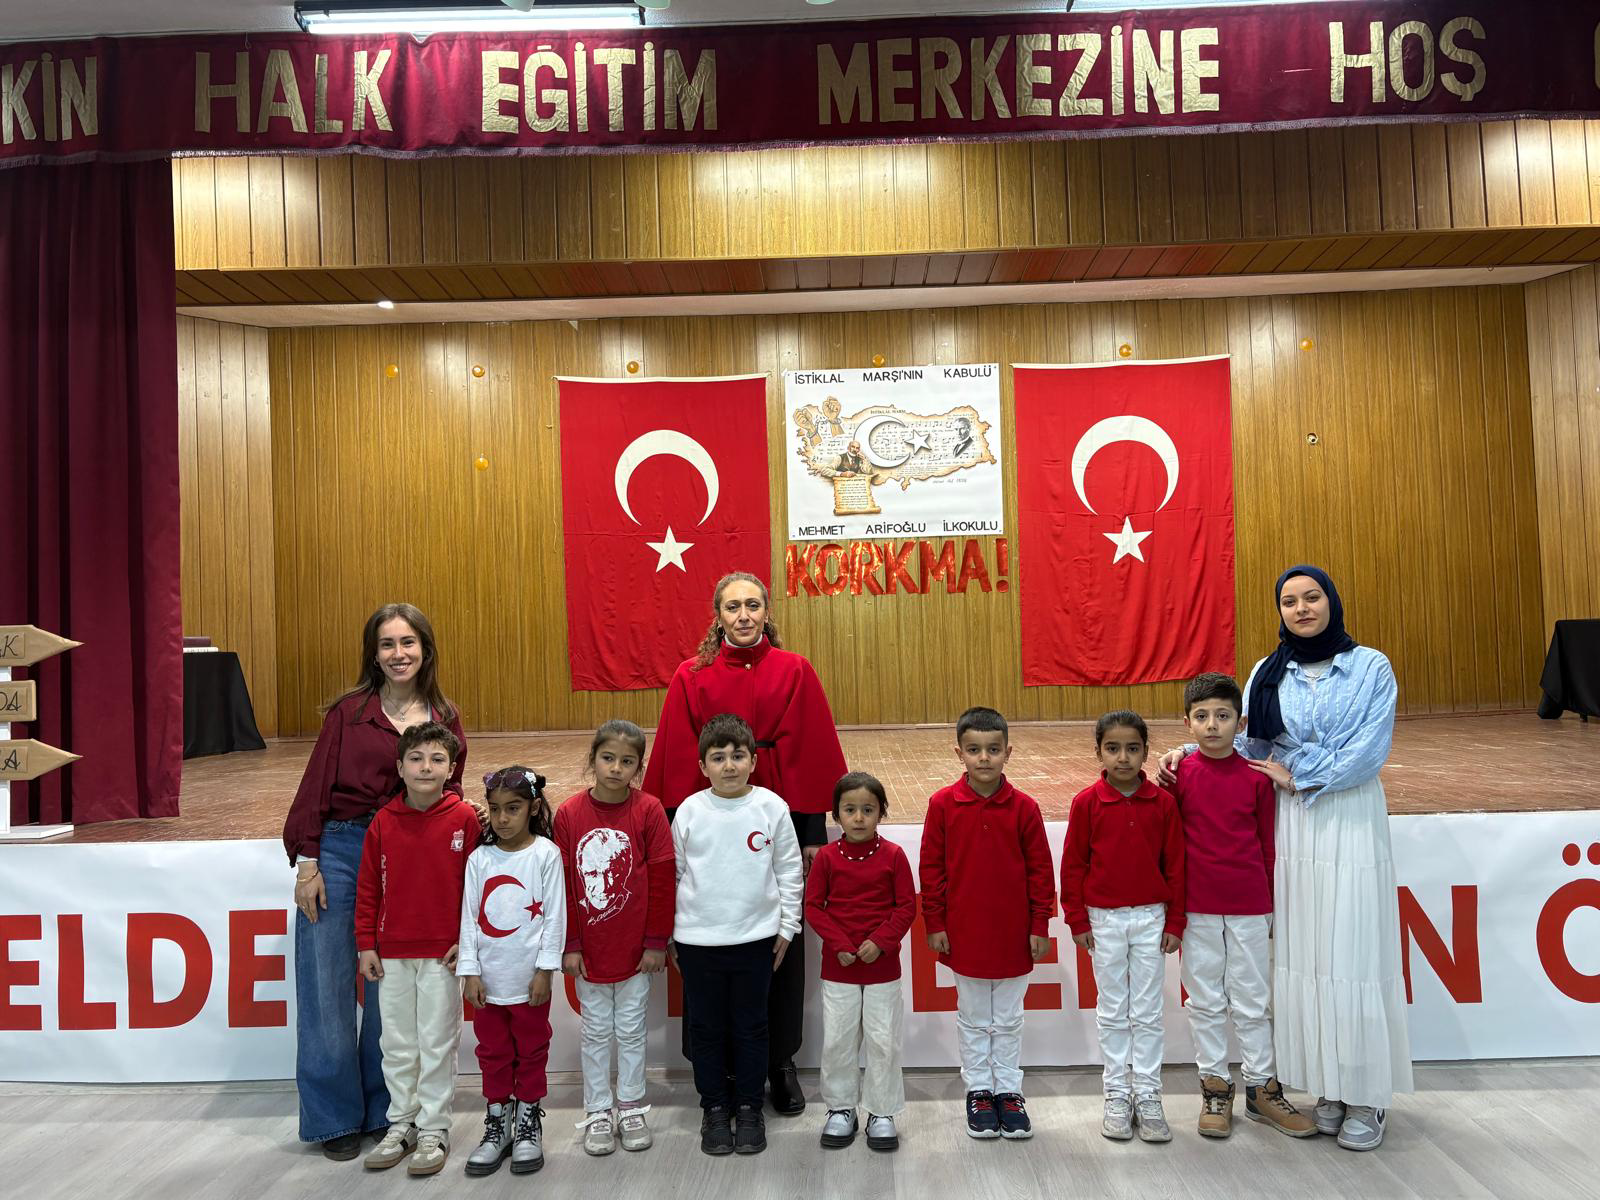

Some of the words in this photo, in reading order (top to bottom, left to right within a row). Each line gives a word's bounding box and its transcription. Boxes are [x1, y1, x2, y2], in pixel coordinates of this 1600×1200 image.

[1, 52, 98, 144] KİN
[195, 48, 394, 133] HALK
[480, 41, 717, 133] EĞİTİM
[816, 25, 1220, 126] MERKEZİNE
[1329, 16, 1487, 104] HOŞ
[794, 372, 845, 385] İSTİKLAL
[862, 369, 923, 383] MARŞI'NIN
[943, 365, 992, 379] KABULÜ
[798, 525, 846, 537] MEHMET
[865, 521, 926, 535] ARİFOĞLU
[942, 519, 998, 533] İLKOKULU
[785, 538, 1009, 598] KORKMA!
